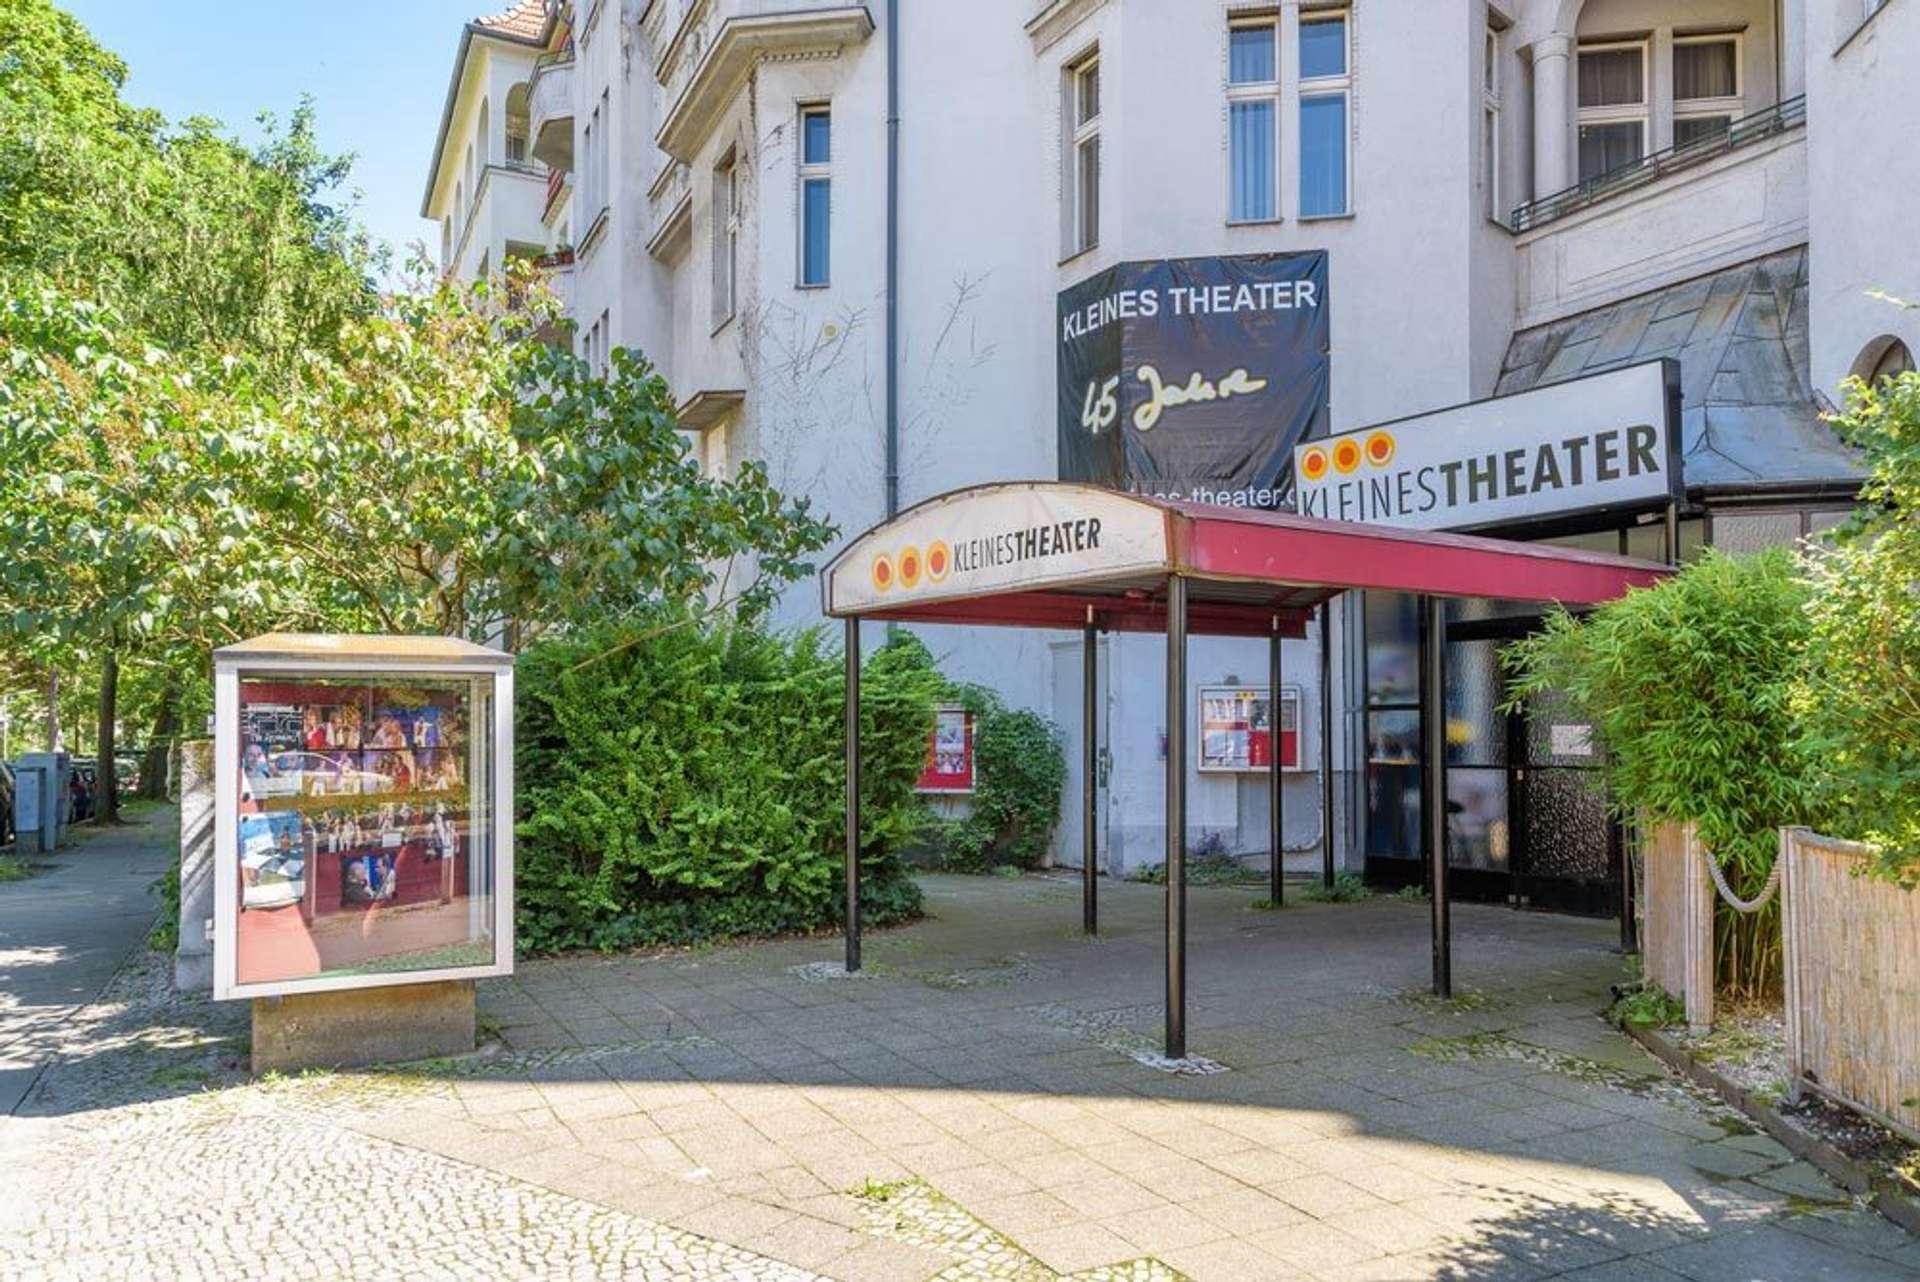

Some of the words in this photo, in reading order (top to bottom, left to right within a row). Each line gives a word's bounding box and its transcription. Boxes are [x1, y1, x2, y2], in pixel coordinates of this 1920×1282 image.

[1062, 289, 1159, 342] KLEINES
[1168, 279, 1318, 315] THEATER
[1081, 375, 1120, 434] 45
[1133, 365, 1268, 432] Jahre
[953, 517, 1102, 573] KLEINESTHEATER
